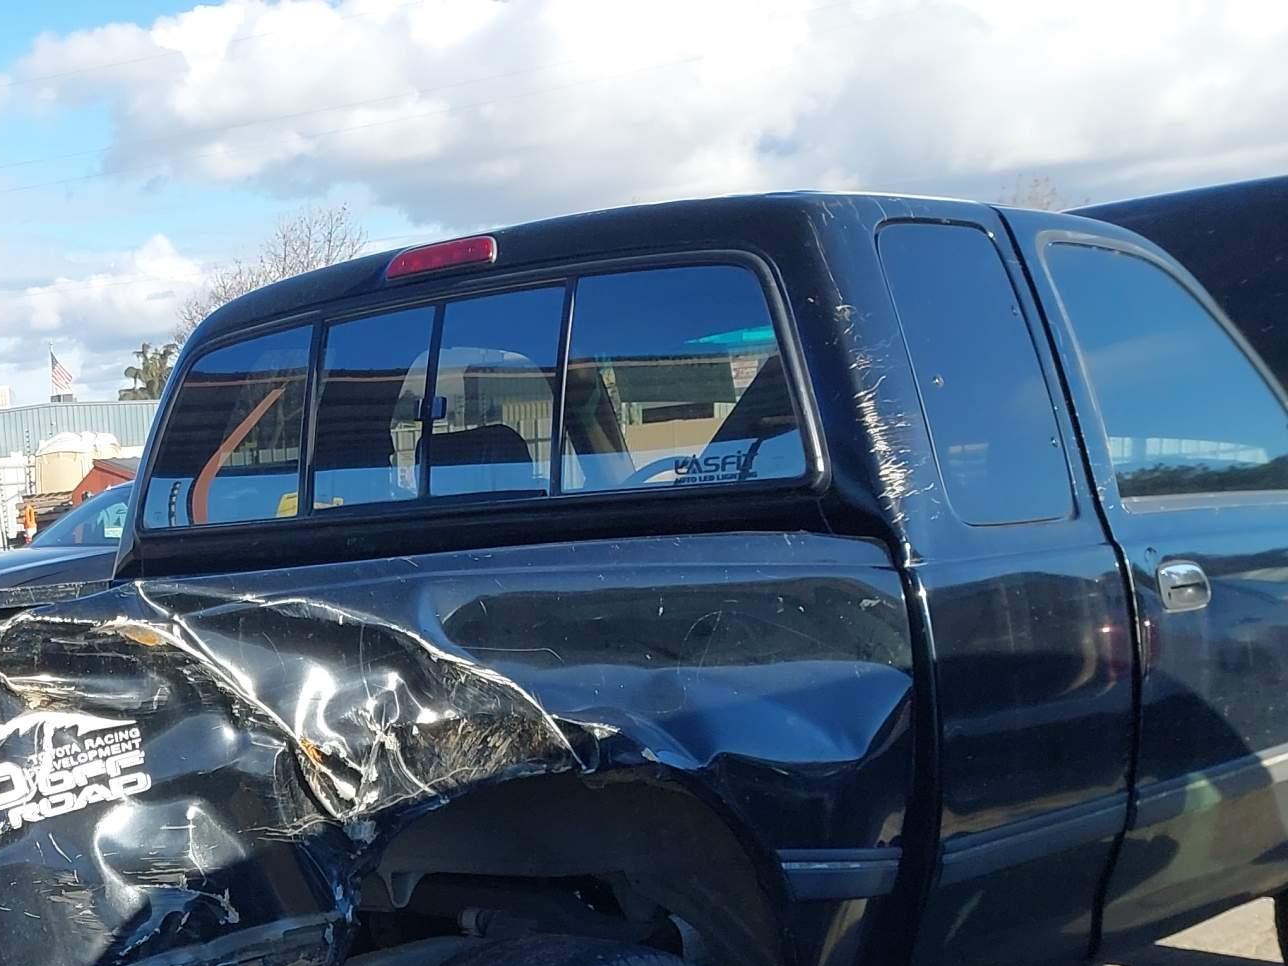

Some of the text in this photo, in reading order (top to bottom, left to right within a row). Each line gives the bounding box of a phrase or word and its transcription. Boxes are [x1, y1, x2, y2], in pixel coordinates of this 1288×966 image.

[717, 471, 758, 481] LIGHNG
[34, 738, 142, 776] VELOPMENT
[84, 728, 141, 750] RACING
[38, 749, 145, 796] OFF
[8, 772, 152, 830] ROAD
